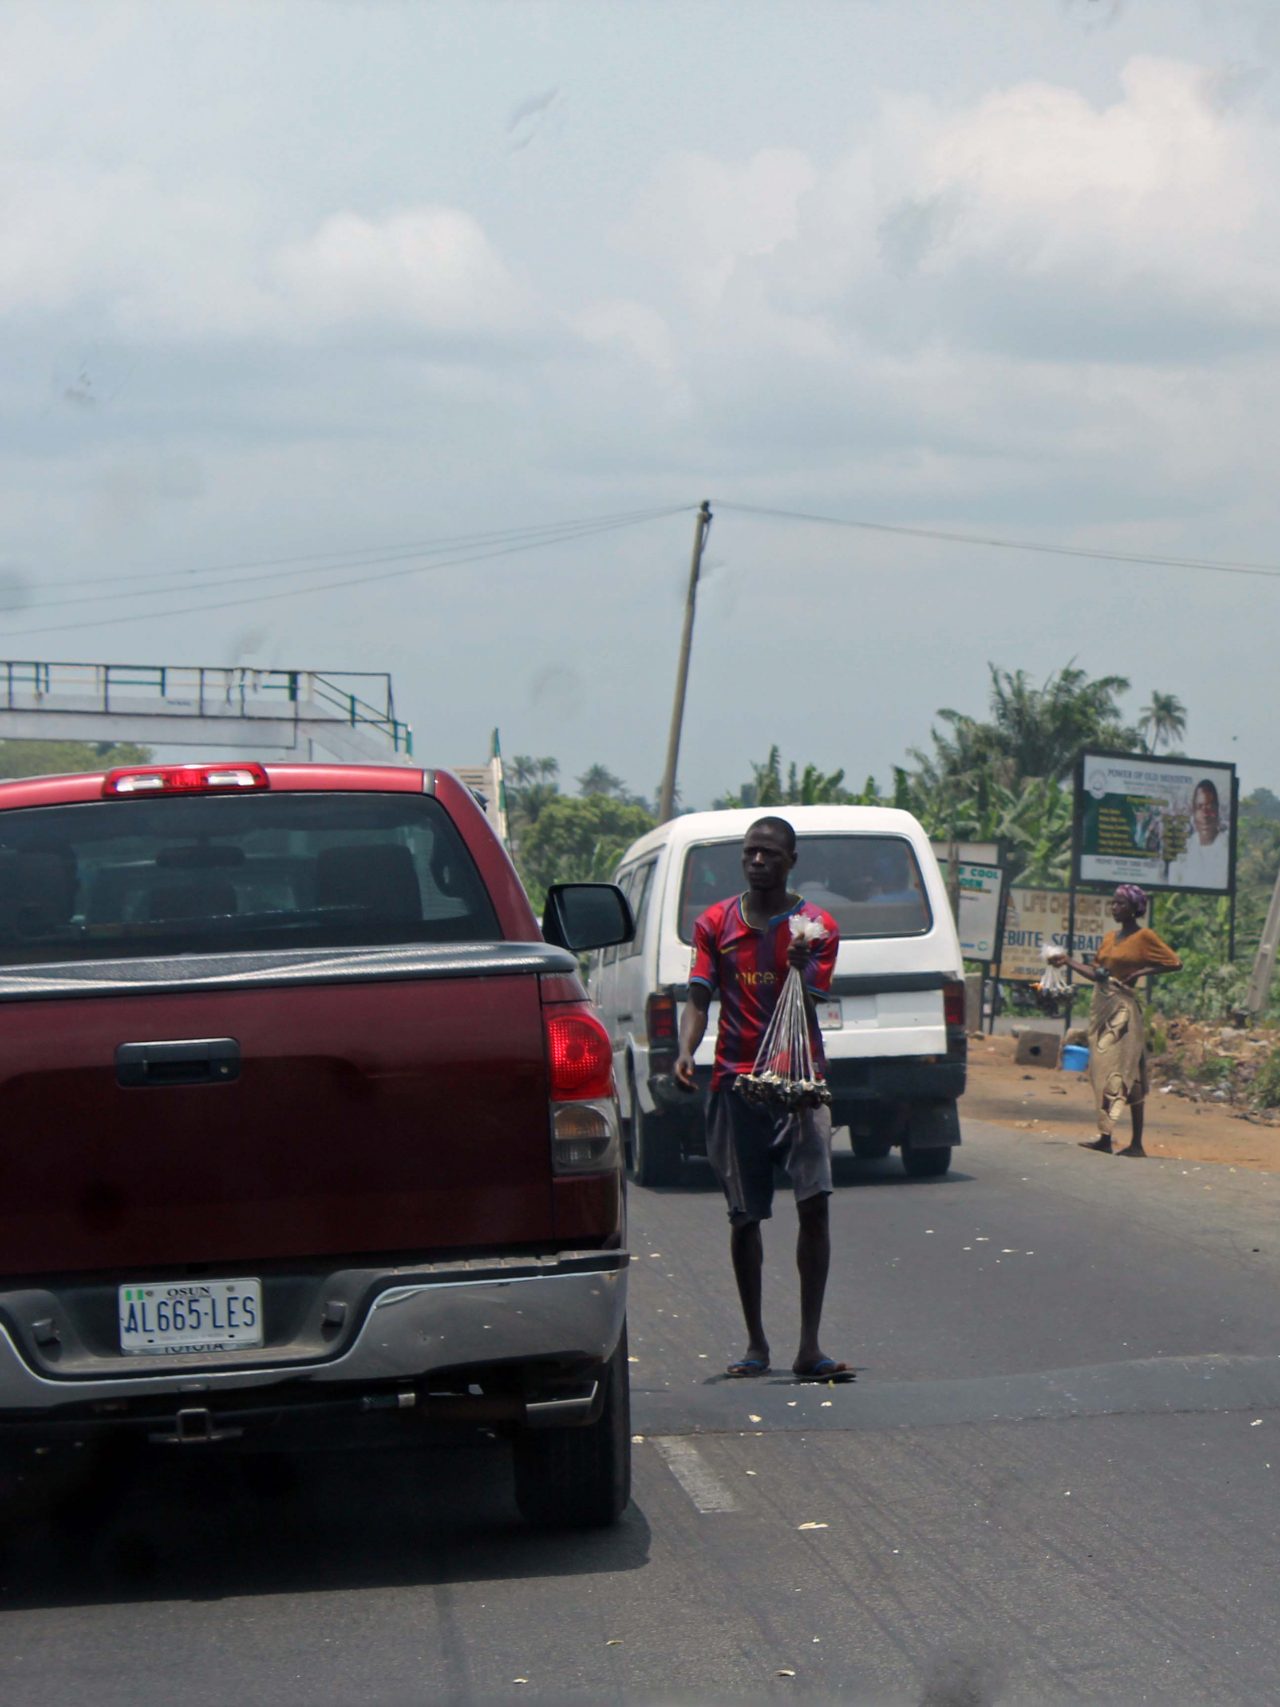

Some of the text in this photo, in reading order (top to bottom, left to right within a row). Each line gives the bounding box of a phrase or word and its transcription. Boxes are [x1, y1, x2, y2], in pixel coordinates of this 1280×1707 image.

[1108, 768, 1132, 778] POWER
[970, 868, 999, 880] COOL
[1022, 892, 1047, 913] LIFE
[1049, 895, 1103, 917] CHGING
[1061, 916, 1104, 933] CURCH
[166, 1286, 211, 1296] OSUN
[123, 1296, 255, 1333] AL665-LES
